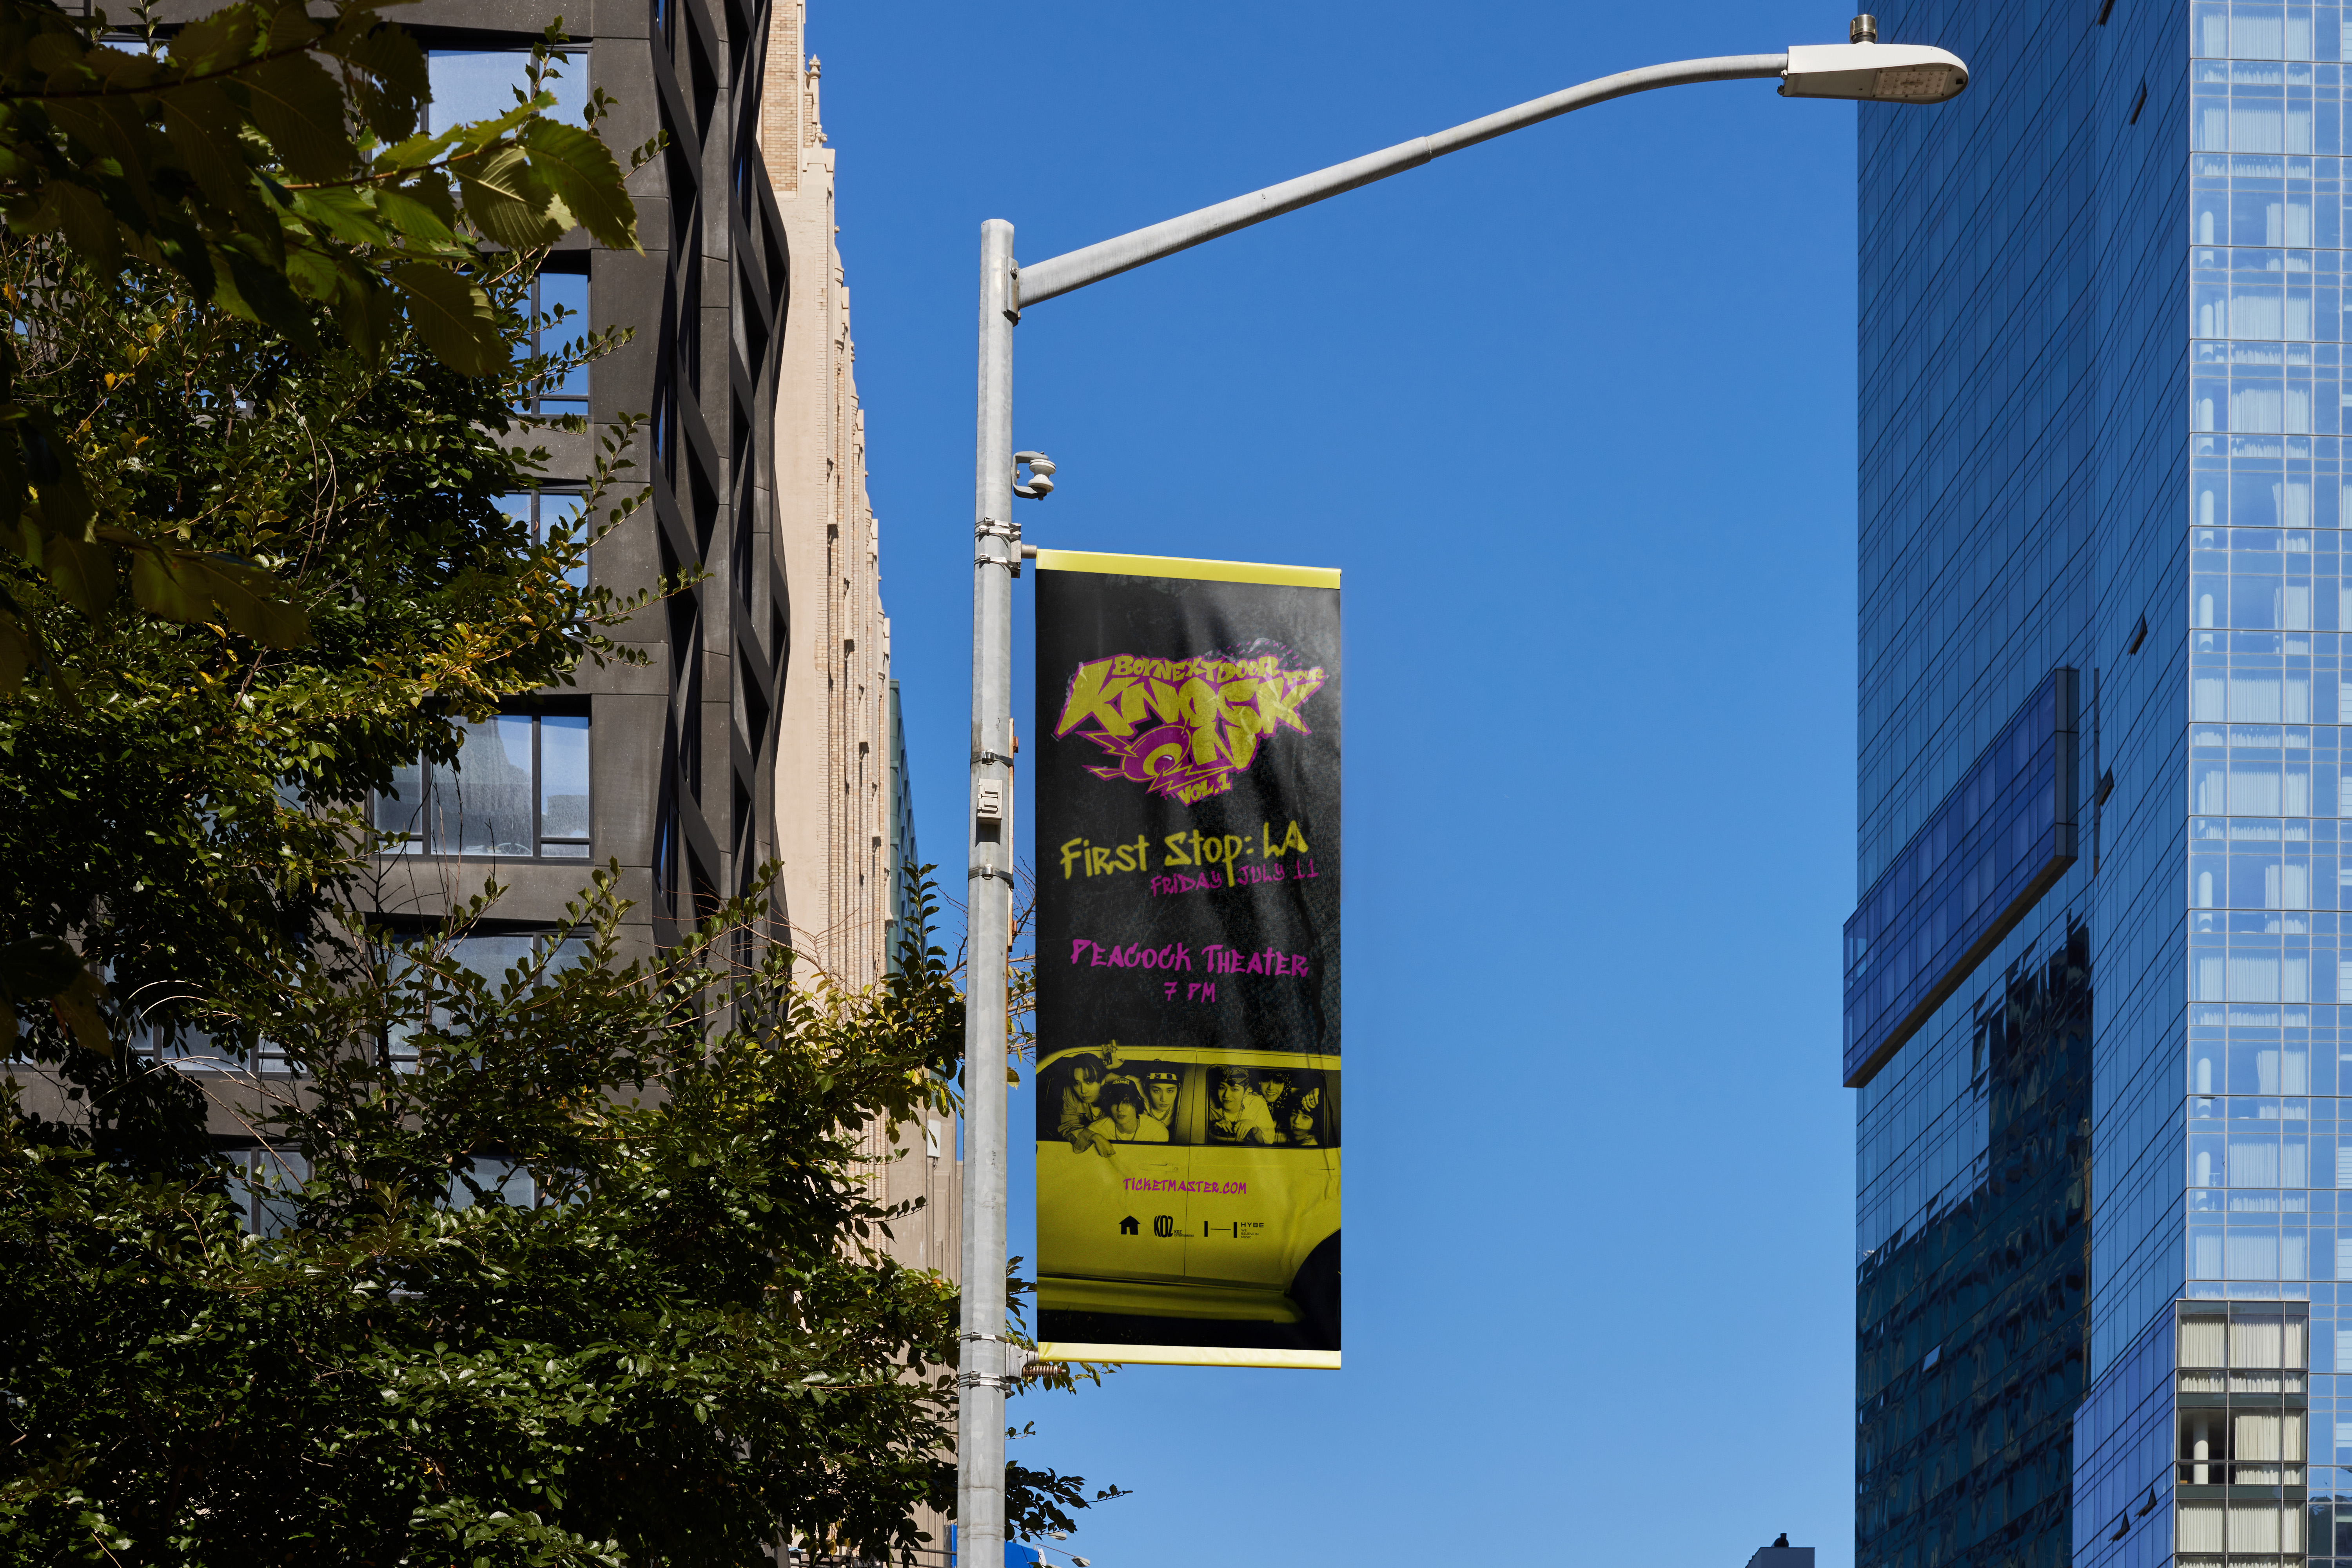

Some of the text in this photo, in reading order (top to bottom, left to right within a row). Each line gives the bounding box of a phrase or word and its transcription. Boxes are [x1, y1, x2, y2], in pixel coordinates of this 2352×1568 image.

[1112, 656, 1325, 686] BOYNEXTDOOR TOUR
[1057, 659, 1320, 736] KNOCK
[1263, 820, 1308, 859] LA
[1151, 858, 1319, 897] FRIDAY JULY 11
[1071, 939, 1309, 978] PEACOCK THEATER
[1163, 981, 1215, 1003] 7 PM
[1123, 1177, 1247, 1195] TICKETMASTER.COM
[1154, 1215, 1173, 1238] KOZ
